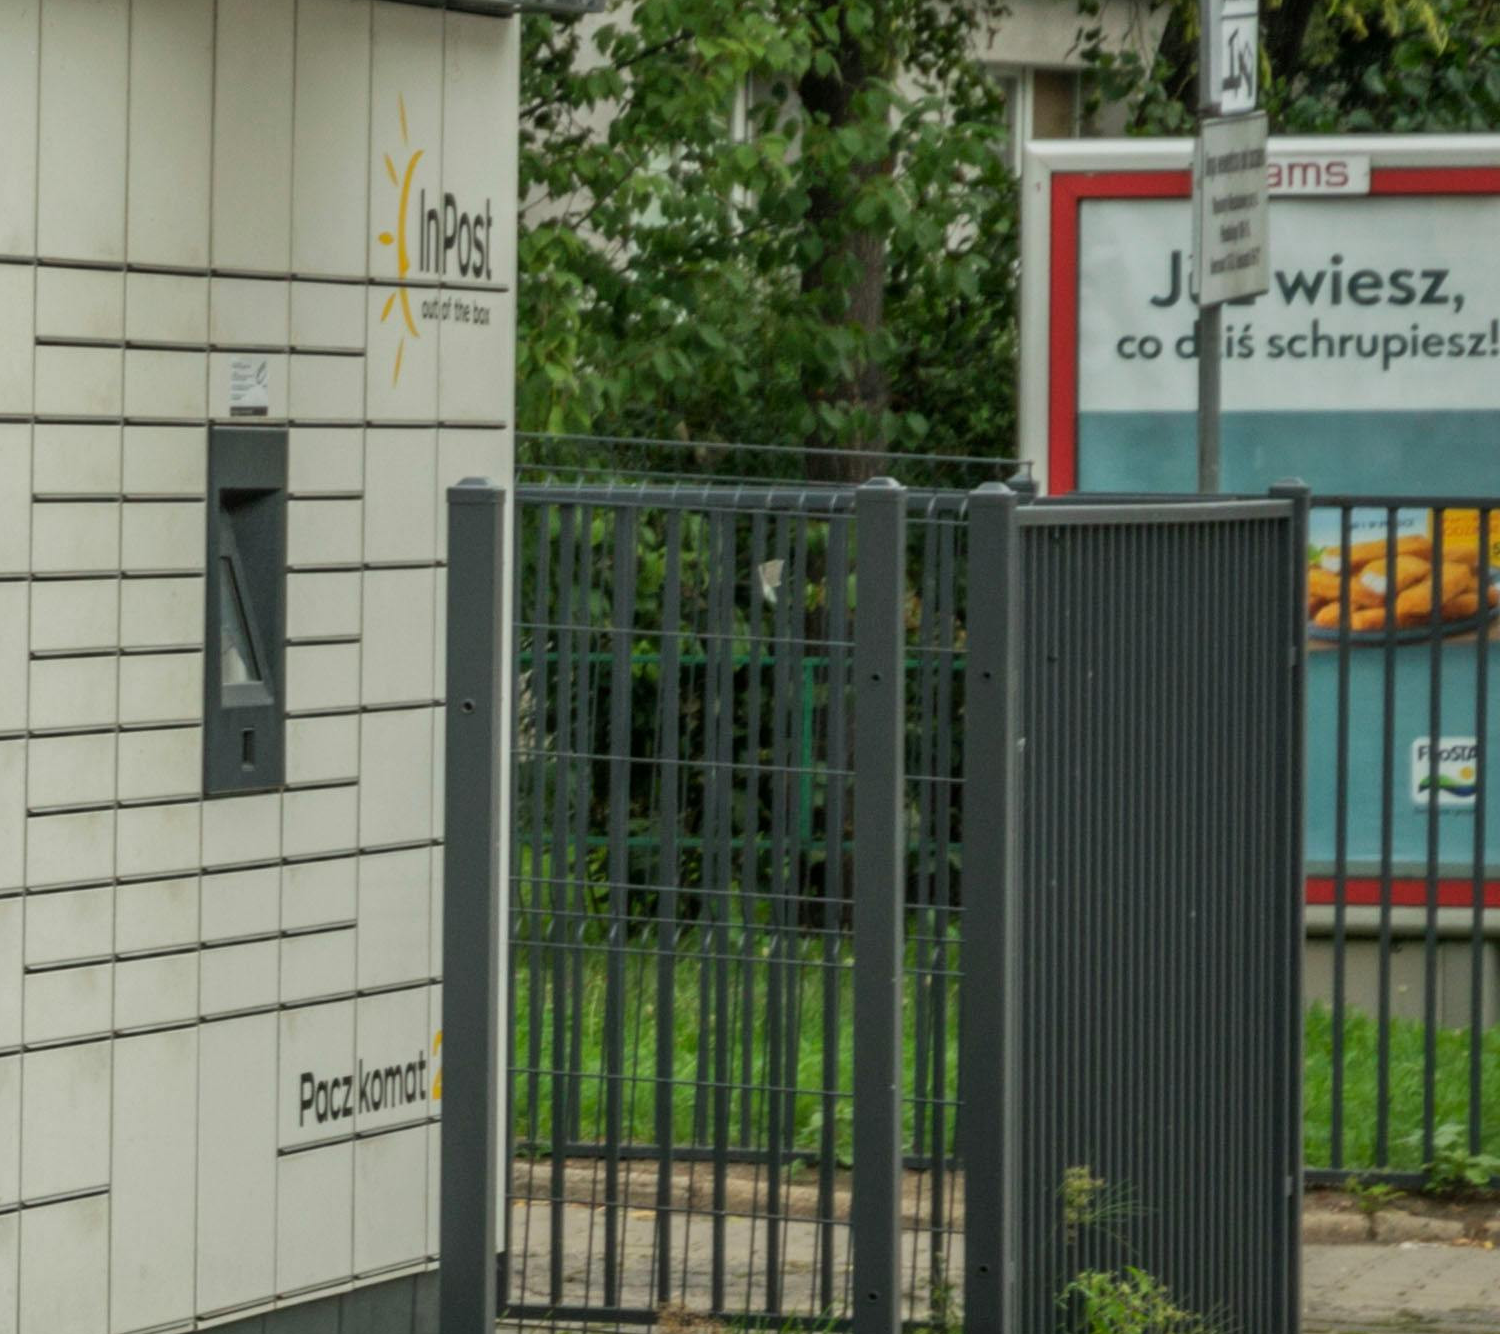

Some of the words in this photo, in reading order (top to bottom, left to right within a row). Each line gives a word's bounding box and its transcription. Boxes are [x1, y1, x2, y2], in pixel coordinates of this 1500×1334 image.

[420, 188, 493, 282] InPost
[1274, 254, 1466, 314] wiesz,
[1116, 333, 1164, 360] co
[1175, 318, 1256, 360] diś
[1265, 318, 1499, 372] schrupiesz!
[299, 1049, 427, 1128] Paczkomat
